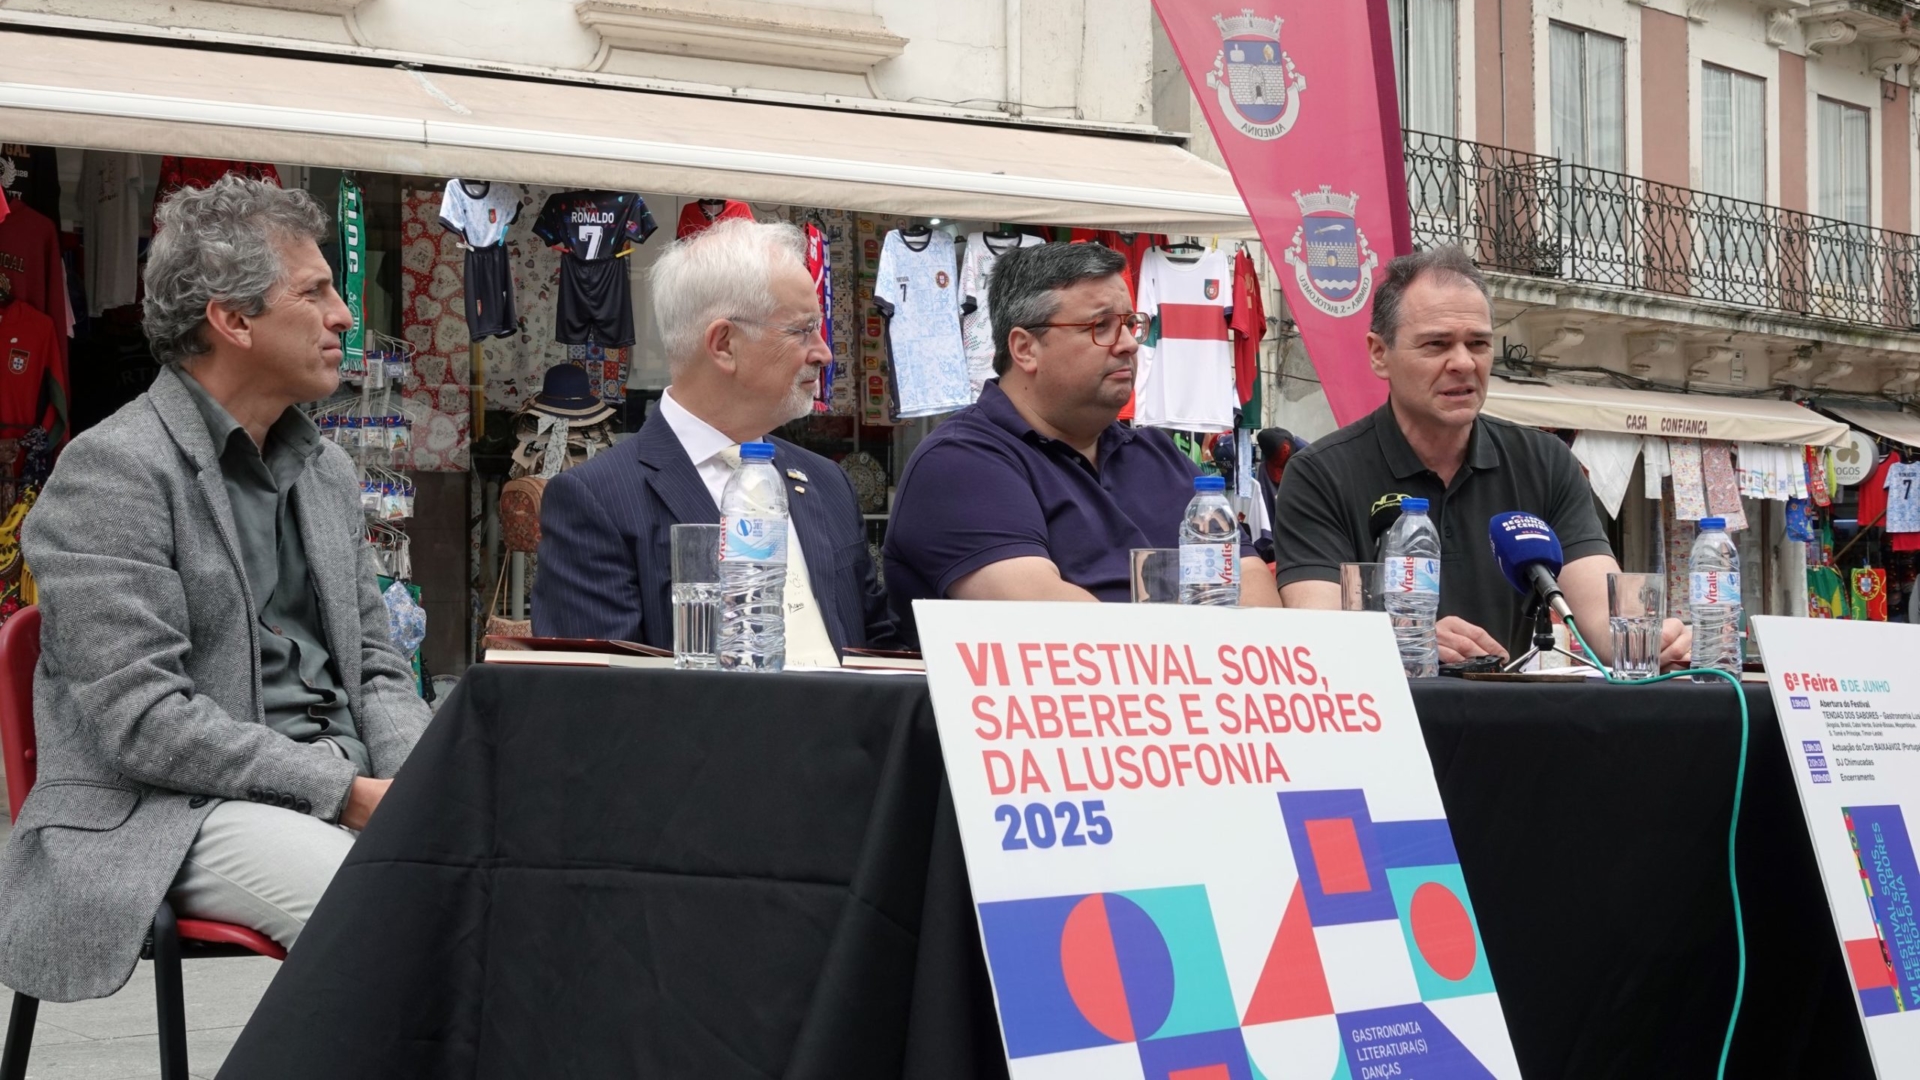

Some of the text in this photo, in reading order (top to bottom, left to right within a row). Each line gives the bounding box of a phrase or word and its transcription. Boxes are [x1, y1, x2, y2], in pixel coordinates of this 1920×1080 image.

[571, 211, 615, 224] RONALDO
[578, 225, 604, 260] 7
[900, 283, 907, 302] 7
[1625, 414, 1648, 431] CASA
[1903, 479, 1912, 500] 7
[1218, 542, 1232, 584] Vitalis
[1400, 555, 1415, 593] Vitalis
[1704, 571, 1717, 604] Vitalis
[955, 643, 1329, 693] VI FESTIVAL SONS,
[1783, 673, 1890, 693] 6ª Feira 6 DE JUNHO
[1820, 700, 1843, 708] Abertura
[1843, 700, 1851, 708] do
[971, 692, 1382, 741] SABERES E SABORES
[1822, 711, 1844, 719] TENDAS
[1844, 711, 1855, 719] DOS
[1855, 711, 1879, 719] SABORES
[1883, 711, 1911, 719] Gastronomia
[1832, 744, 1855, 753] Actuação
[1855, 744, 1862, 752] do
[1862, 744, 1875, 752] Coro
[982, 742, 1291, 795] DA LUSOFONIA
[1836, 758, 1844, 766] DJ
[1844, 758, 1874, 766] Chimucadas
[1840, 774, 1875, 782] Encerramento
[994, 800, 1113, 851] 2025
[1871, 822, 1901, 902] SABORES
[1887, 900, 1915, 981] FESTIVAL
[1352, 1021, 1422, 1042] GASTRONOMIA
[1356, 1038, 1428, 1061] LITERATURA(S)
[1361, 1061, 1401, 1080] DANÇAS
